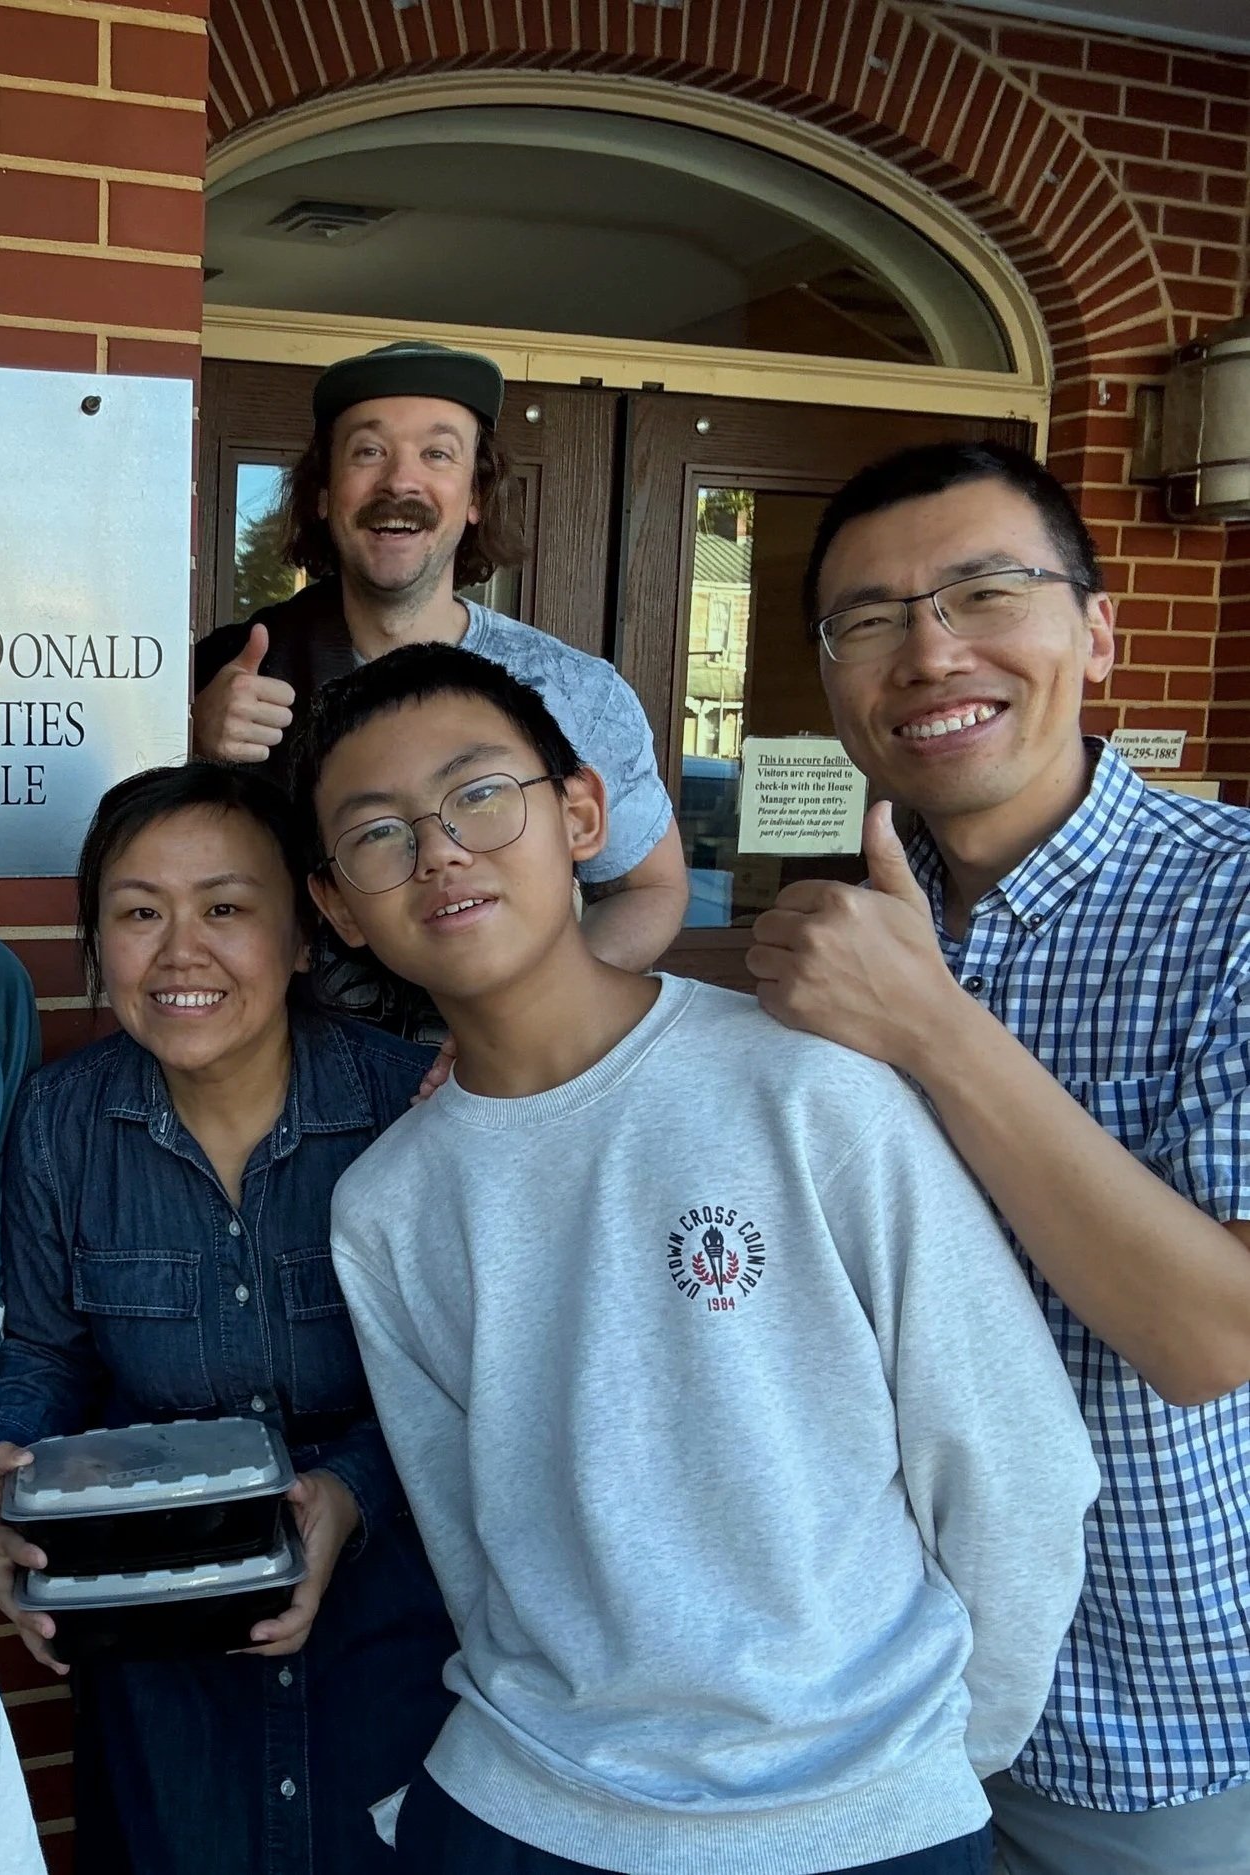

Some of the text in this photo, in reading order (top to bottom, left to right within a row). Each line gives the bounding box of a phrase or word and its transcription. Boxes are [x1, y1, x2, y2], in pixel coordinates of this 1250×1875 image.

[758, 754, 776, 764] This
[778, 755, 784, 764] is
[793, 757, 821, 765] secure
[757, 768, 788, 777] Visitors
[806, 769, 842, 780] required
[755, 781, 853, 791] check-in with the House
[760, 795, 846, 807] Manager upon entry.
[758, 807, 778, 815] Please
[779, 807, 787, 815] do
[800, 809, 818, 817] open
[758, 818, 768, 827] for
[769, 818, 805, 826] individuals
[806, 818, 821, 826] that
[759, 830, 774, 838] part
[774, 829, 783, 838] of
[667, 1206, 766, 1300] UPTOWN CROSS COUNTRY
[707, 1296, 735, 1312] 1984
